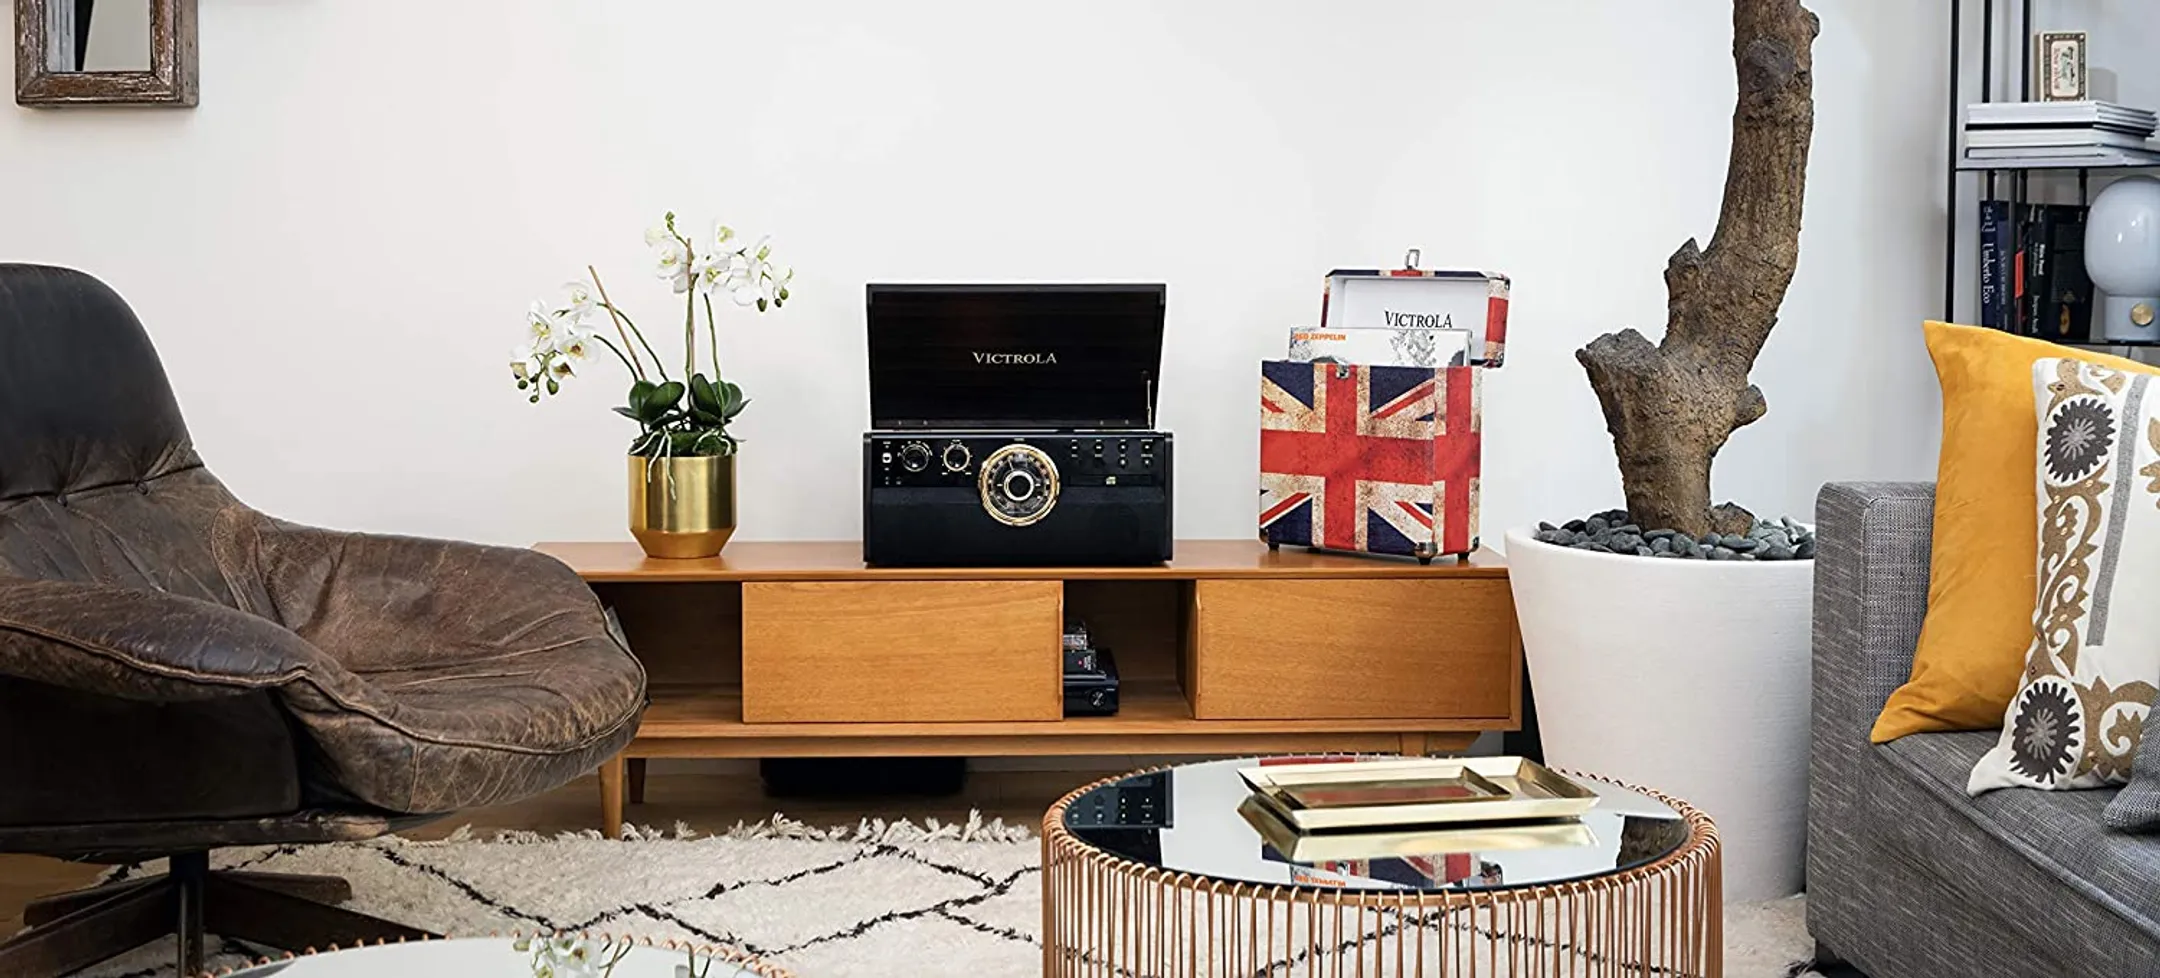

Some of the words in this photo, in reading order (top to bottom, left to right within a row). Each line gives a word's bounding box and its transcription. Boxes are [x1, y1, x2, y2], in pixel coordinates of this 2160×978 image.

[1982, 243, 1996, 283] Umberto
[1983, 285, 1995, 304] Eco
[1384, 310, 1453, 328] VICTROLA
[1311, 332, 1346, 341] ZEPPELIN
[972, 351, 1057, 364] VICTROLA
